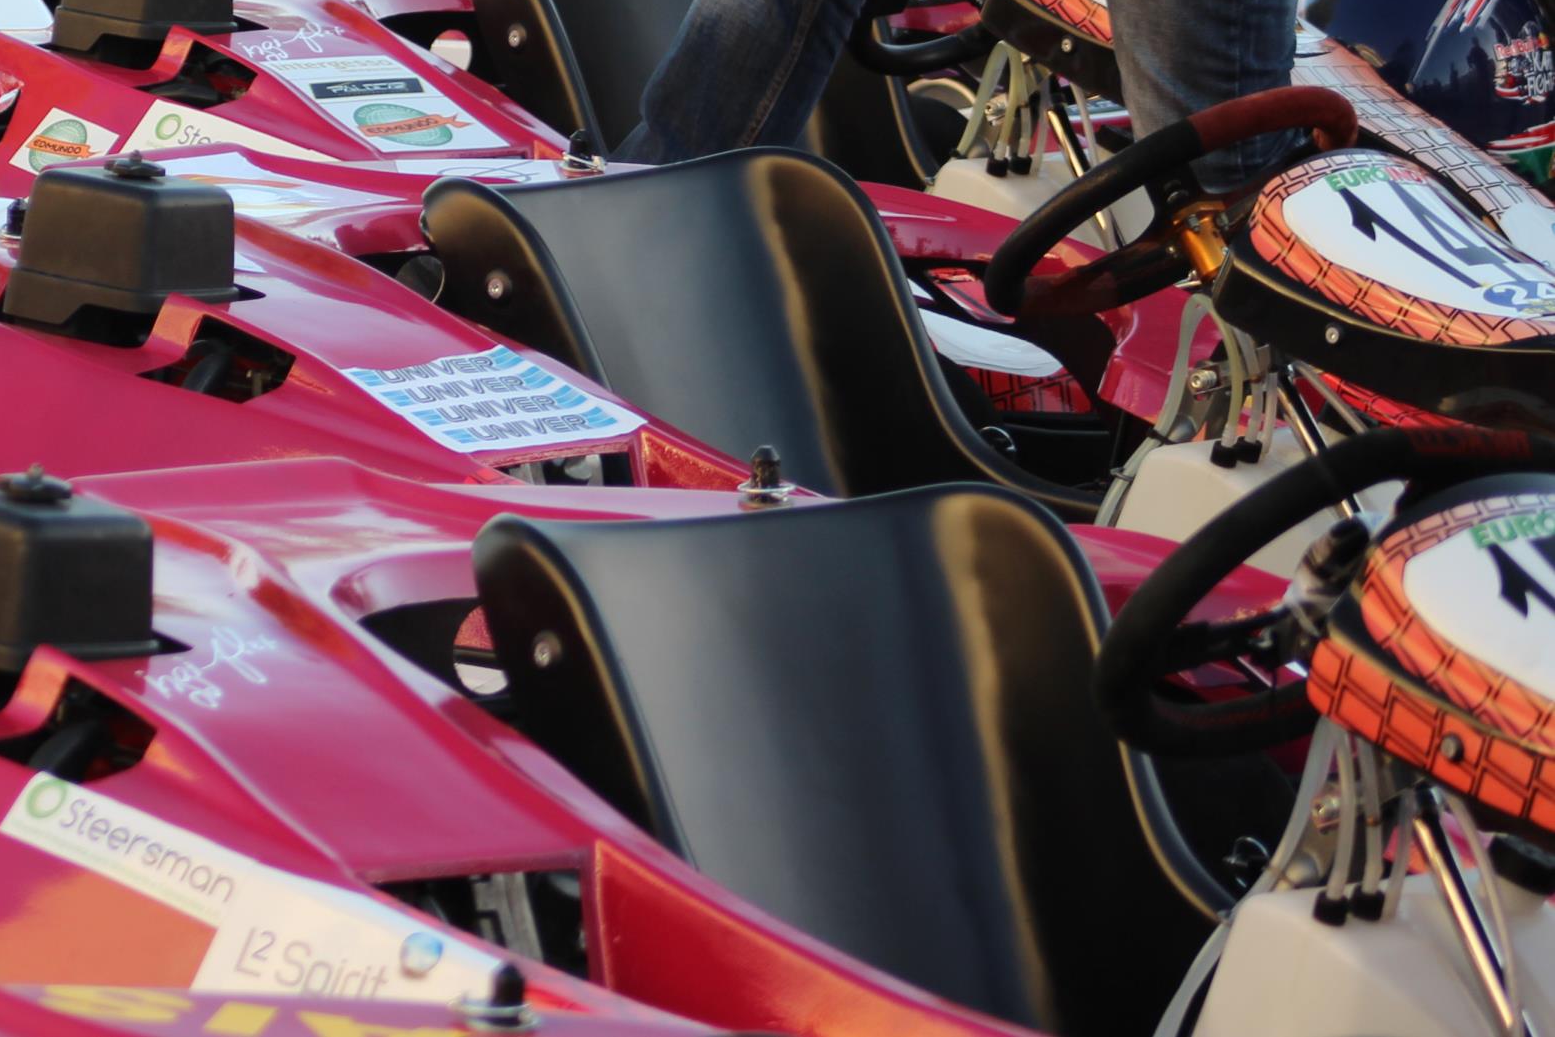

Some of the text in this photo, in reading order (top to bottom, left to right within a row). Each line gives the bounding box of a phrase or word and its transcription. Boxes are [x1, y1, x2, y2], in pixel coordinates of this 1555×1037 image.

[365, 116, 440, 137] EDMUNDO
[32, 138, 83, 155] EDMUNDO
[374, 355, 495, 385] UNIVER
[404, 374, 525, 404] UNIVER
[435, 394, 558, 423] UNIVER
[468, 414, 592, 442] UNIVER
[59, 797, 238, 904] Steersman
[275, 939, 391, 1000] Spirit
